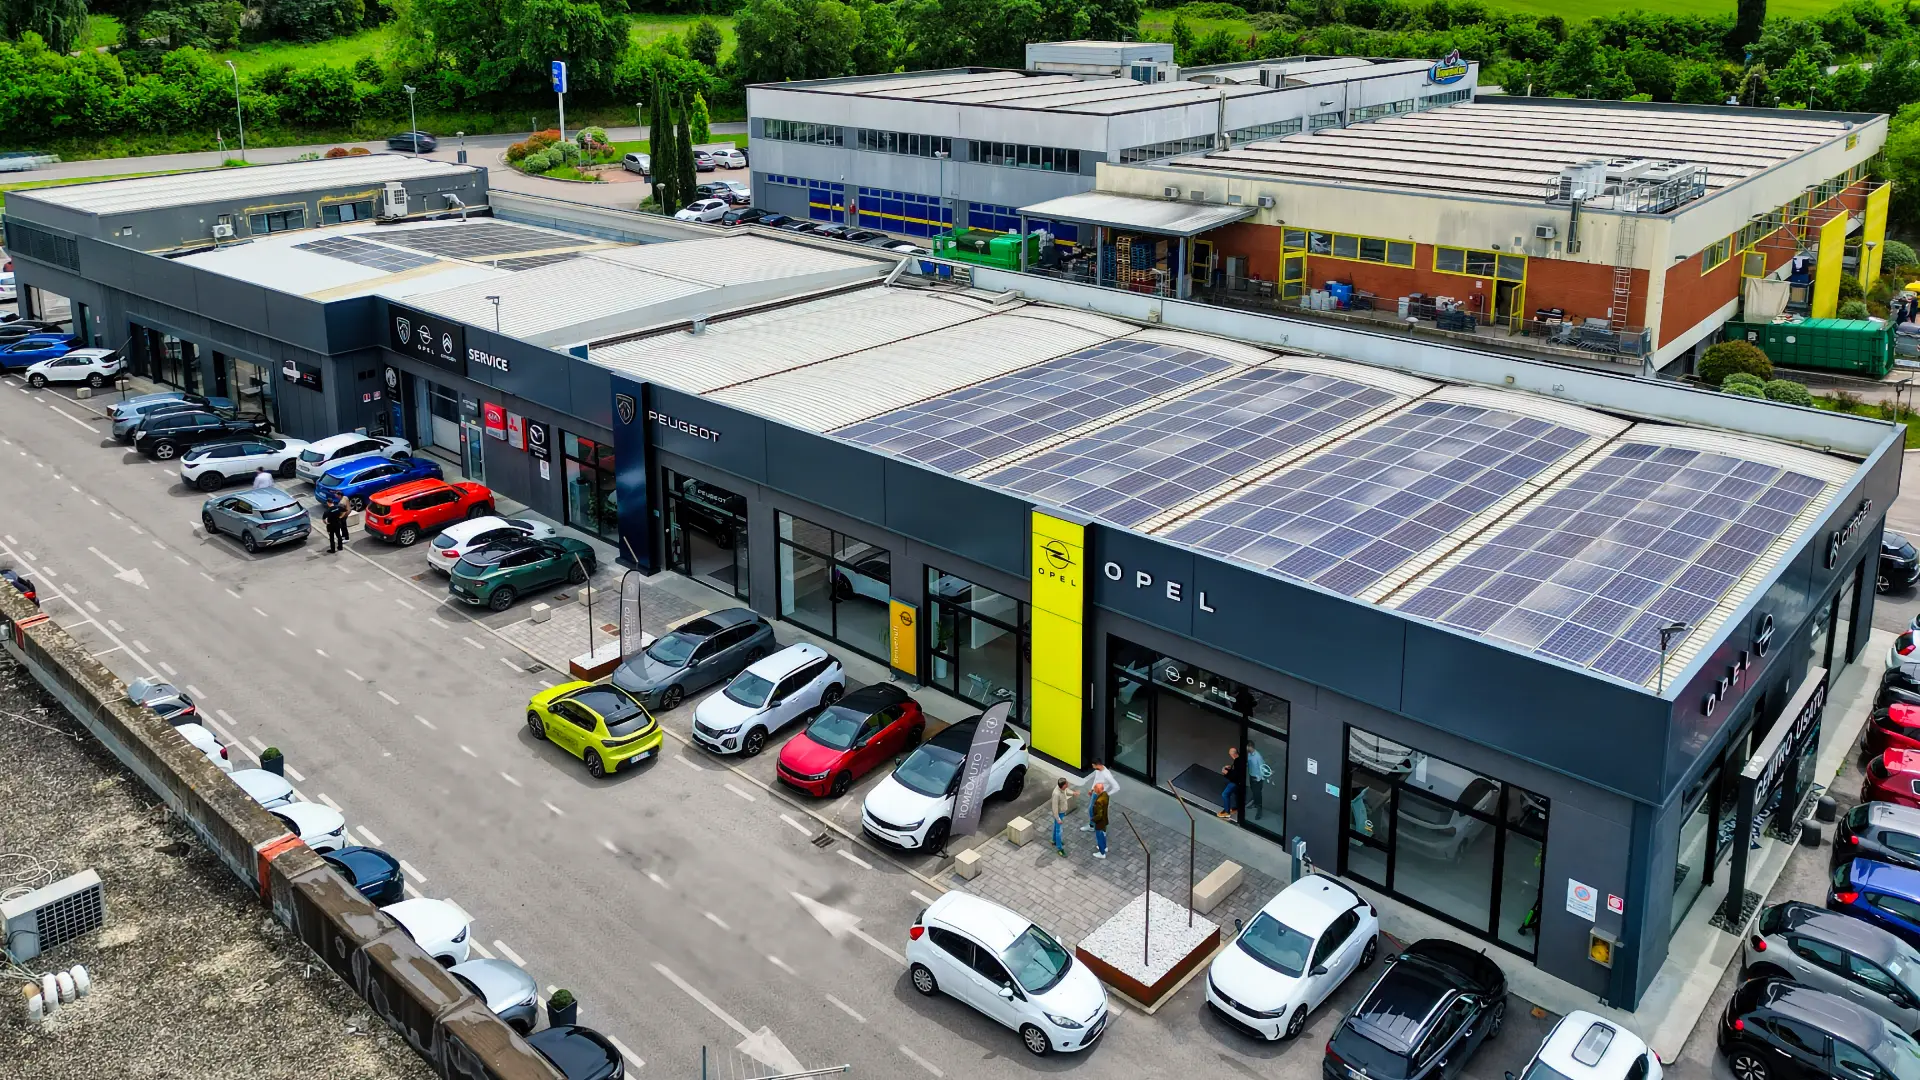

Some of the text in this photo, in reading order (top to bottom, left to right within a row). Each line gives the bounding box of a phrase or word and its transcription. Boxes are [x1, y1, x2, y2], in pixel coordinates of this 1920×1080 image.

[417, 344, 434, 355] OPEL
[468, 348, 508, 371] SERVICE
[648, 410, 719, 442] PEUGEOT
[697, 488, 726, 504] PEUGEOT
[1038, 567, 1076, 587] OPEL
[1104, 561, 1214, 613] OPEL
[1186, 676, 1230, 700] OPEL
[1707, 650, 1751, 717] OPEL
[1754, 731, 1793, 805] CENTRO
[1795, 685, 1824, 740] USATO
[958, 752, 982, 819] ROMEOAUTO
